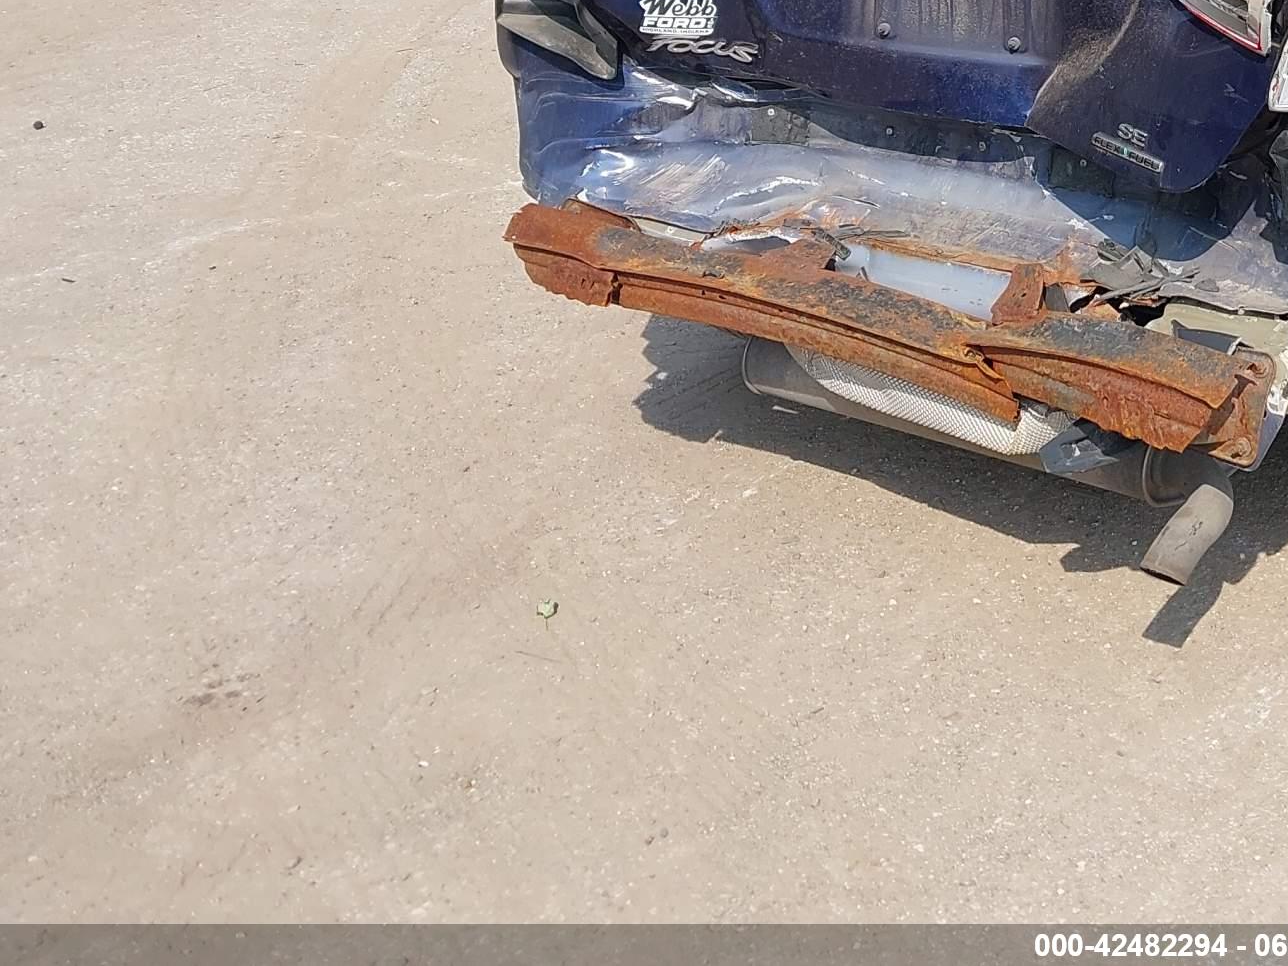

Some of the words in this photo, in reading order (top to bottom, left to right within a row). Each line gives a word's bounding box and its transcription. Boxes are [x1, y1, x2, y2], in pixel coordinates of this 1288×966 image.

[643, 17, 707, 29] FORD
[1117, 123, 1148, 147] SE
[1094, 136, 1120, 153] FLEX
[1129, 151, 1160, 170] FUEL
